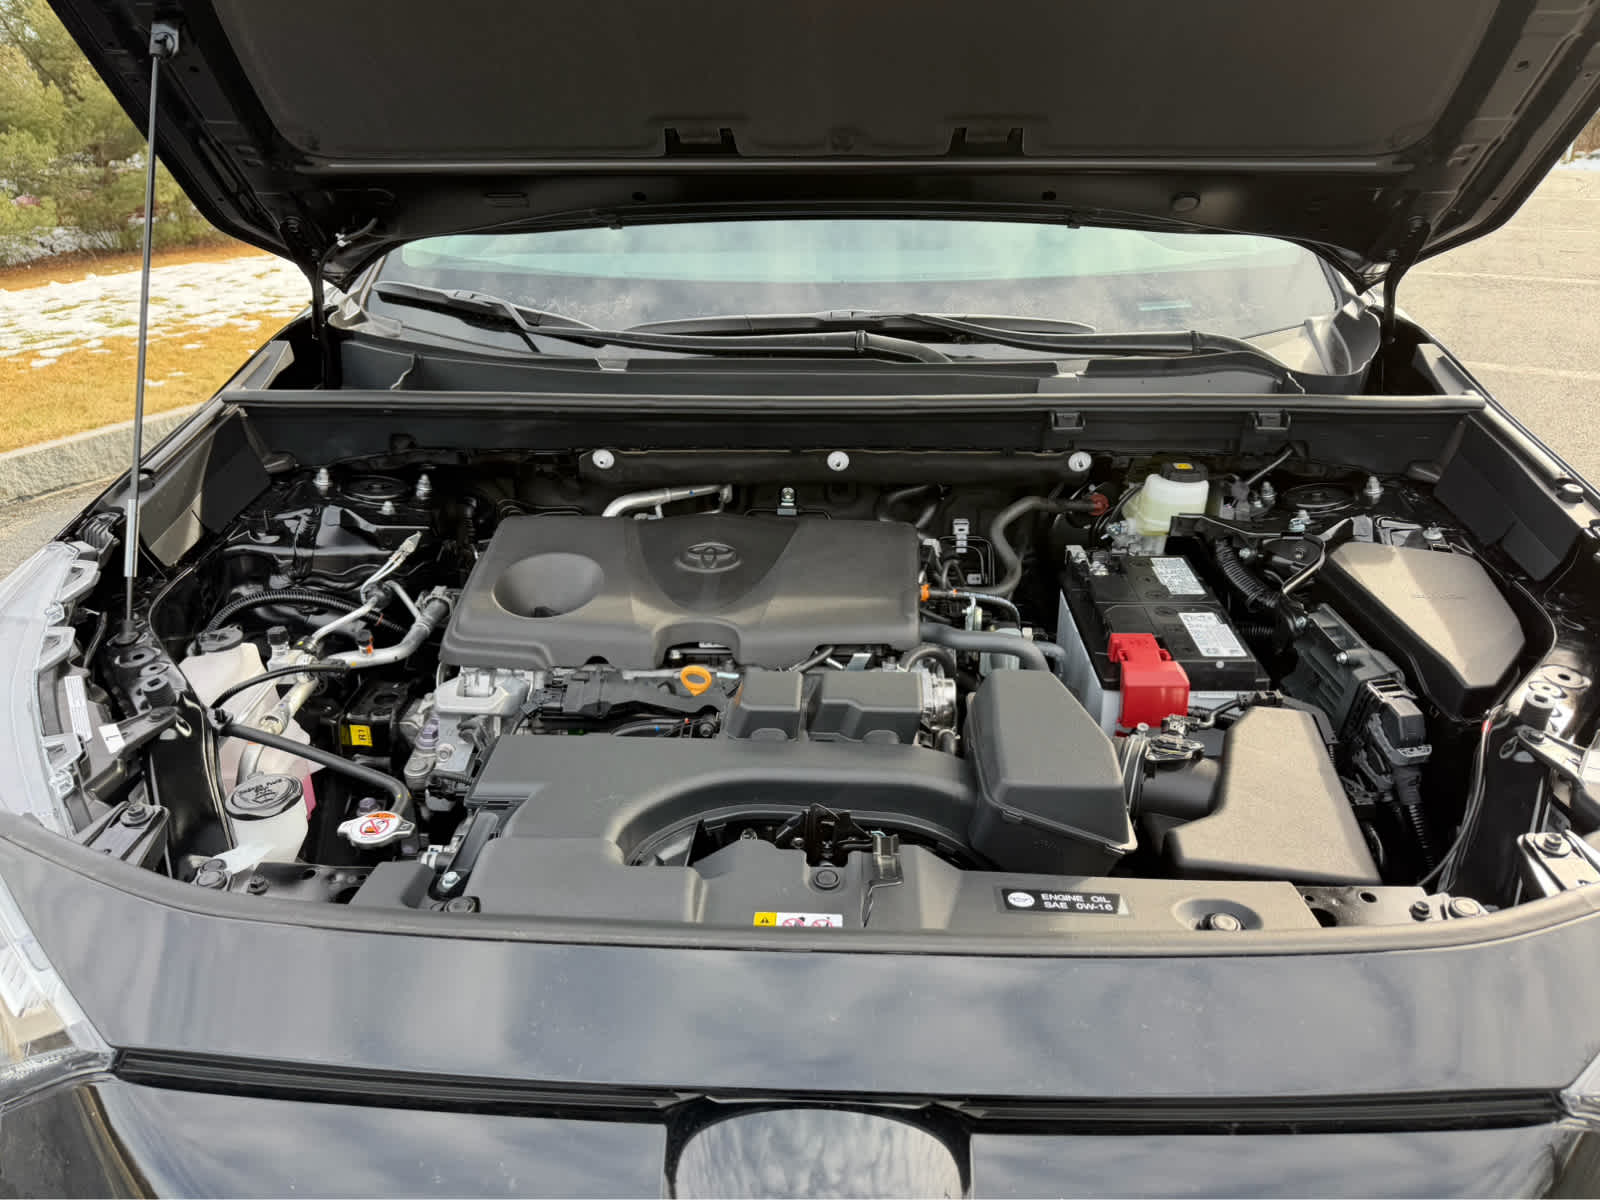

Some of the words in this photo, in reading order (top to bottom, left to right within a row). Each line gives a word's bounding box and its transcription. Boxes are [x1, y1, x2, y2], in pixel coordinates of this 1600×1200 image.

[1040, 893, 1084, 902] ENGINE
[1090, 895, 1111, 903] OIL
[1043, 901, 1069, 909] SAE
